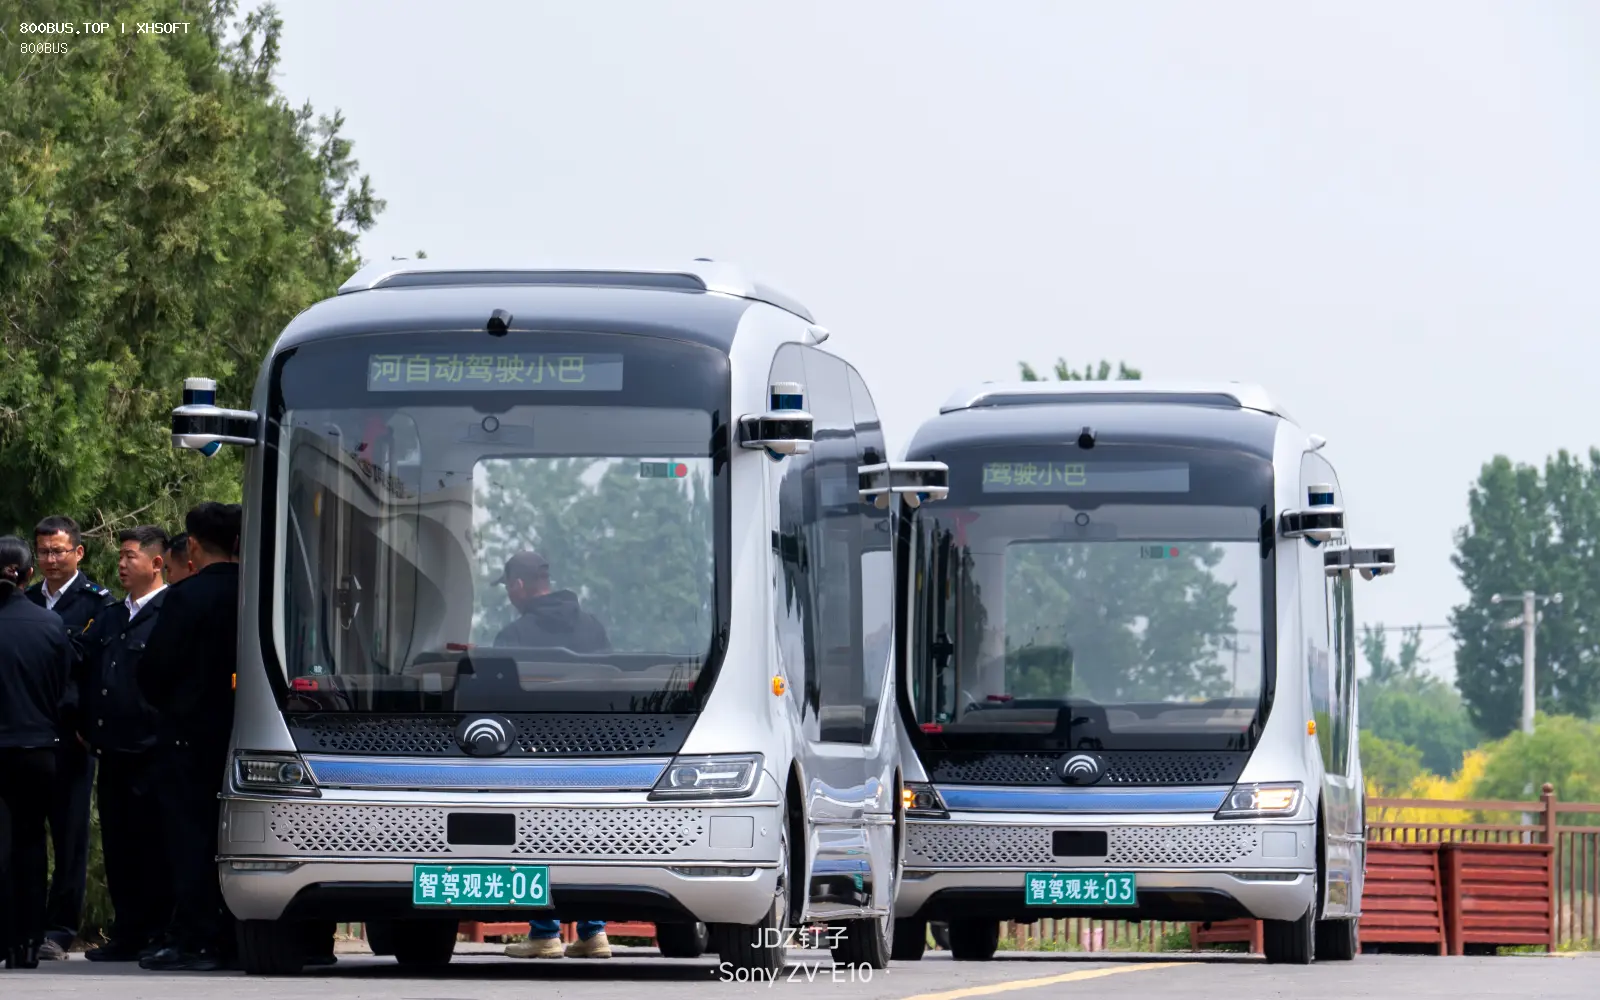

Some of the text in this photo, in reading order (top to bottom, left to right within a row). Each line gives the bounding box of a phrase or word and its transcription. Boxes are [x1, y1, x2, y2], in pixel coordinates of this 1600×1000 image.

[372, 353, 587, 384] 河自动驾驶小巴
[982, 462, 1088, 487] 驾驶小巴
[419, 872, 544, 900] 智驾观光·06
[1030, 878, 1132, 900] 智驾观光·03
